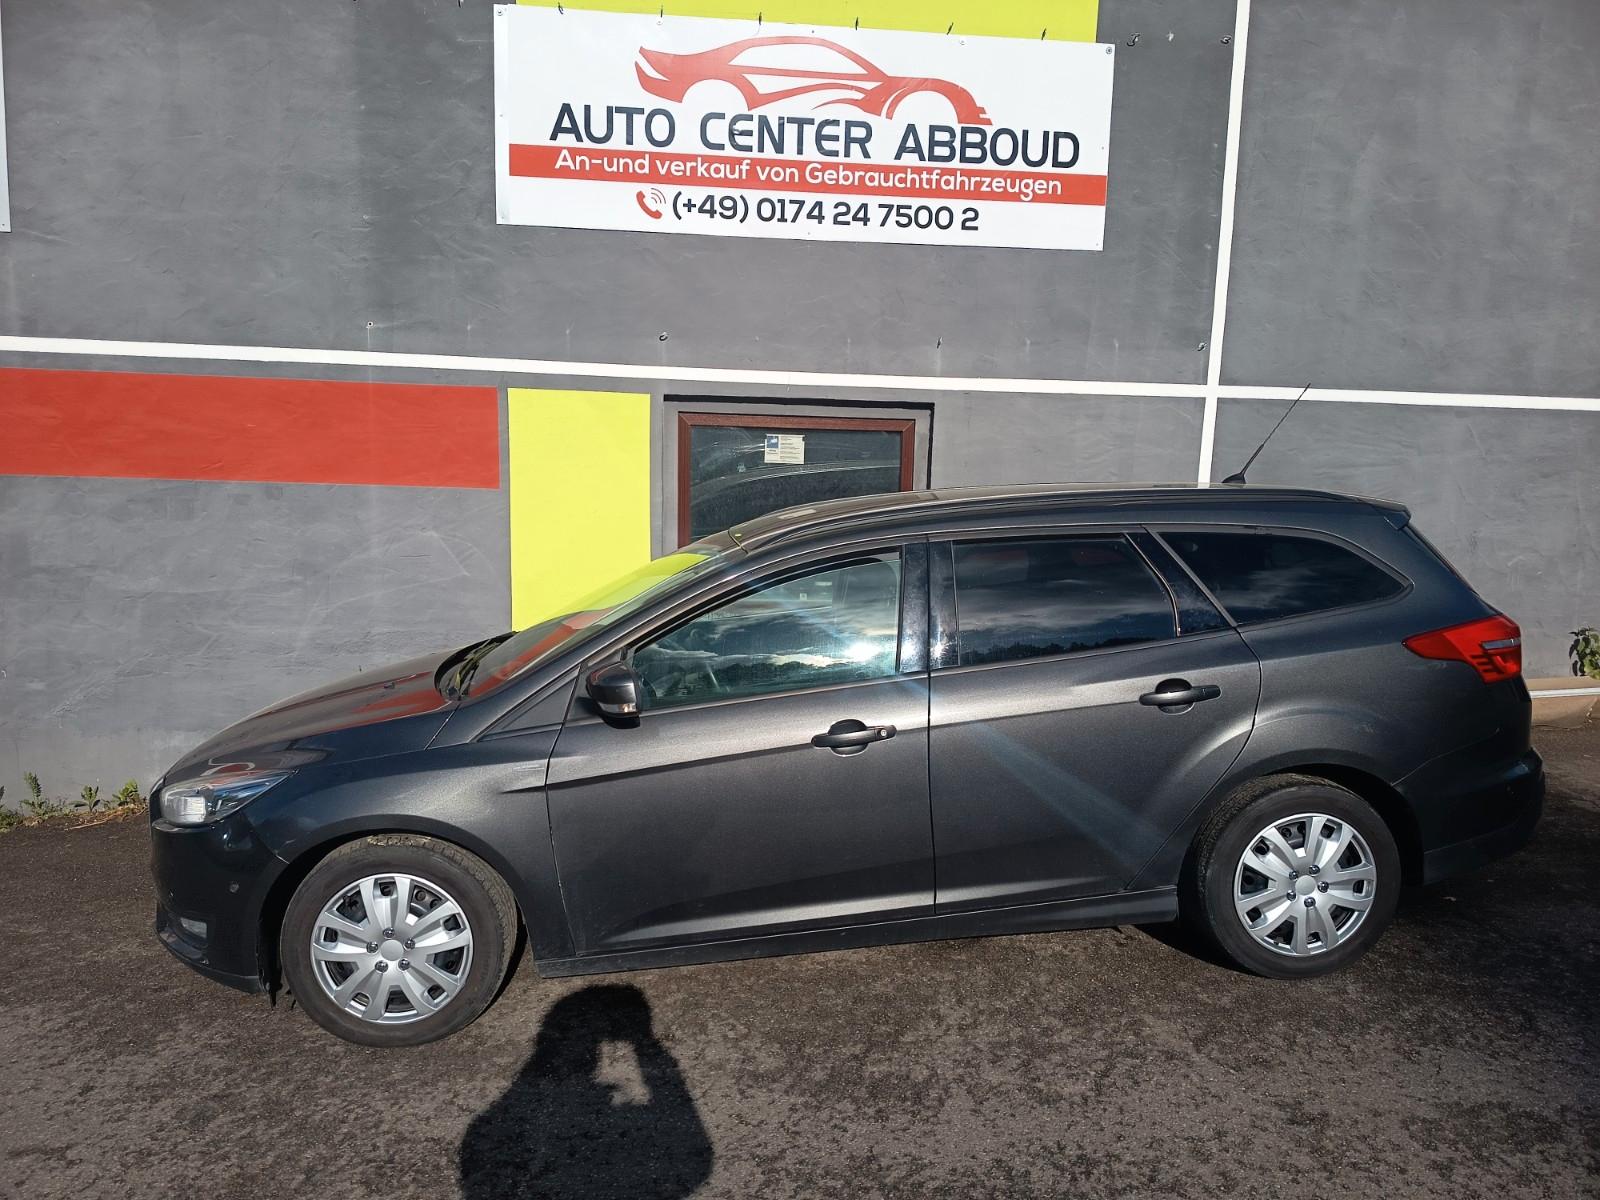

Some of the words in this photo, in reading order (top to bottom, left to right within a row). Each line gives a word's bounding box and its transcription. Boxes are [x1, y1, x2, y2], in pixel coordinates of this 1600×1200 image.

[549, 102, 676, 148] AUTO
[700, 111, 873, 160] CENTER
[894, 123, 1080, 169] ABBOUD
[554, 149, 650, 175] An-und
[656, 157, 751, 180] verkauf
[756, 164, 799, 183] von
[805, 163, 1062, 202] Gebrauchtfahrzeugen
[672, 191, 750, 224] (+49)
[756, 197, 826, 225] 0174
[832, 201, 871, 227] 24
